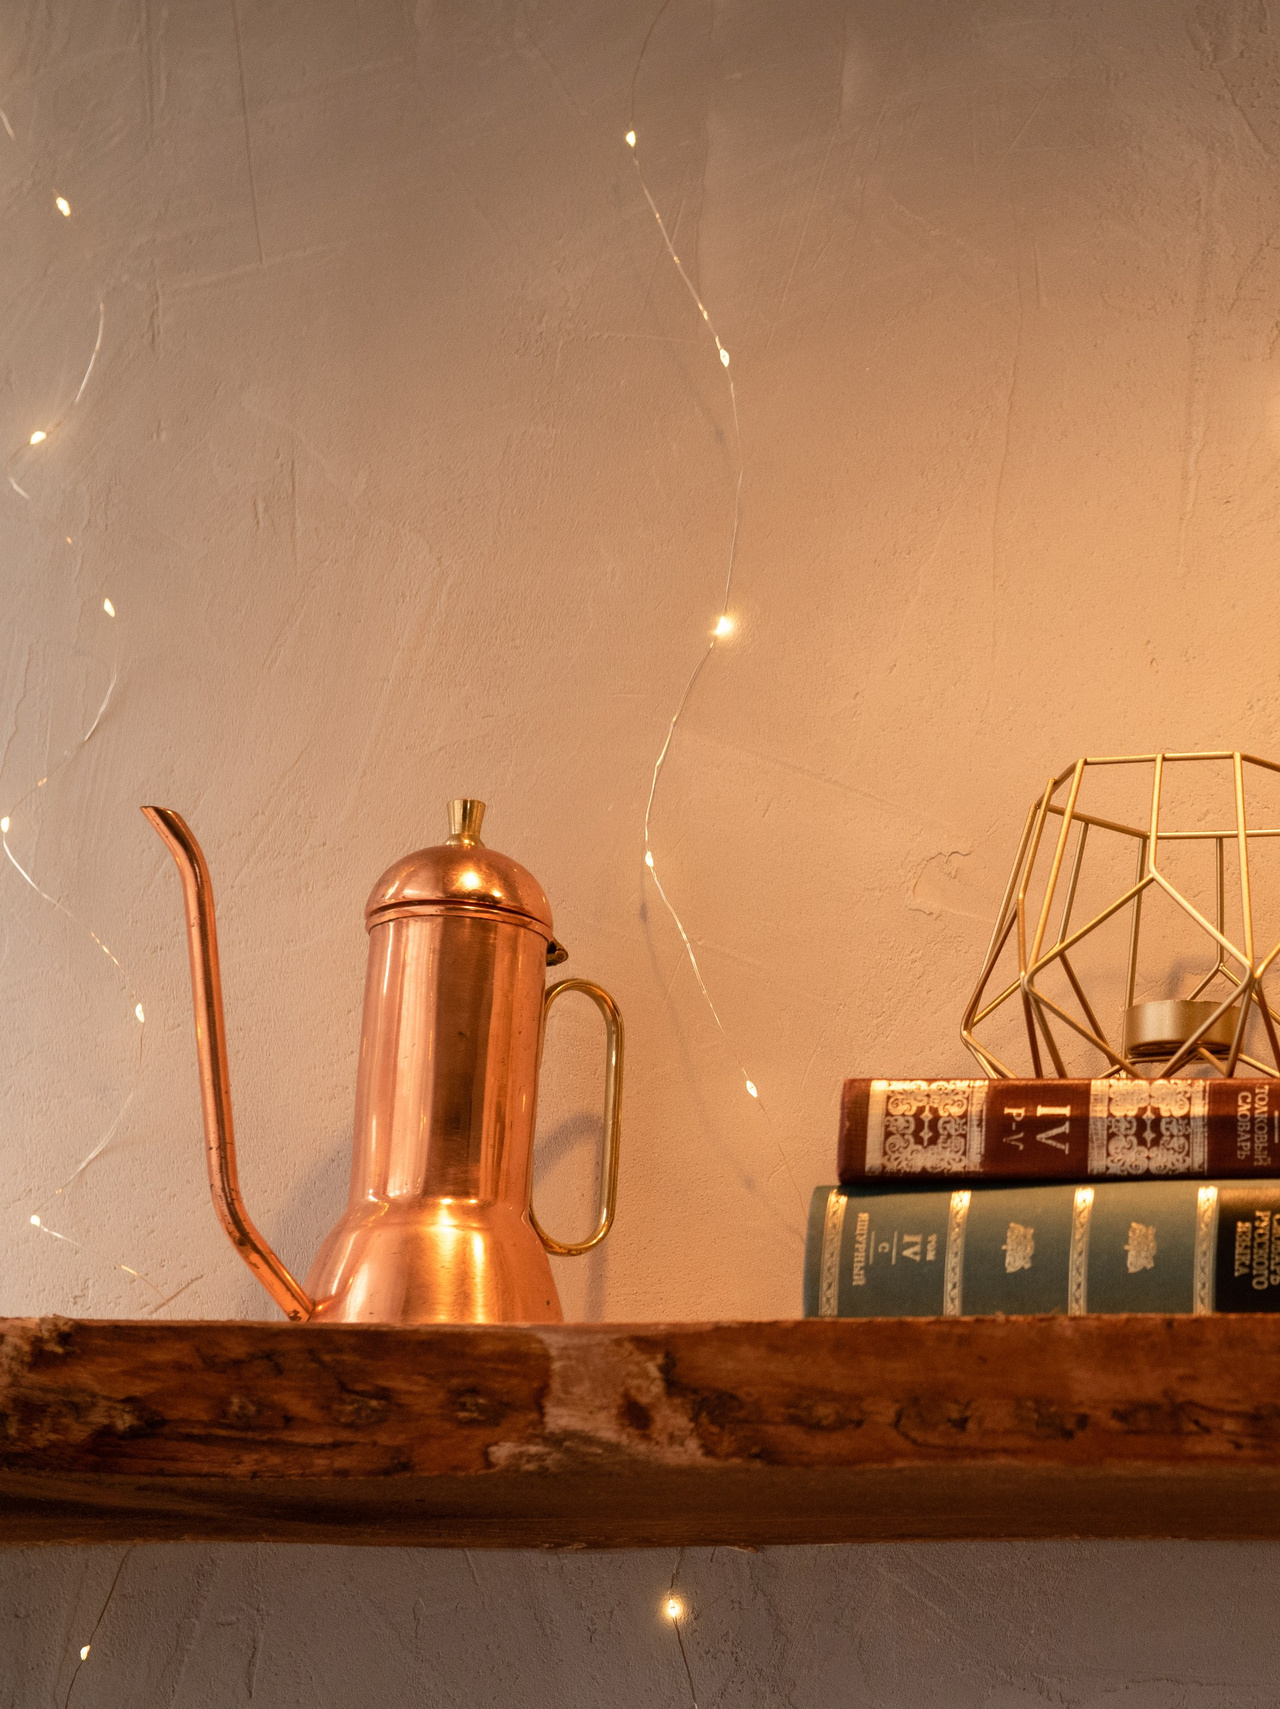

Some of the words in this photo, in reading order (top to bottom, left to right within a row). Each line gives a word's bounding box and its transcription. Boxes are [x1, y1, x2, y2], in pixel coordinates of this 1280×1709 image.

[1036, 1105, 1071, 1155] IV
[1237, 1091, 1252, 1159] СЛОВАРЬ
[1254, 1084, 1271, 1166] ТОЛКОВЫЙ
[852, 1212, 869, 1286] ЯЩУРНЫЙ
[902, 1234, 923, 1262] IV
[1234, 1221, 1252, 1278] ЯЗЫКА
[1252, 1210, 1271, 1290] РУССКОГО
